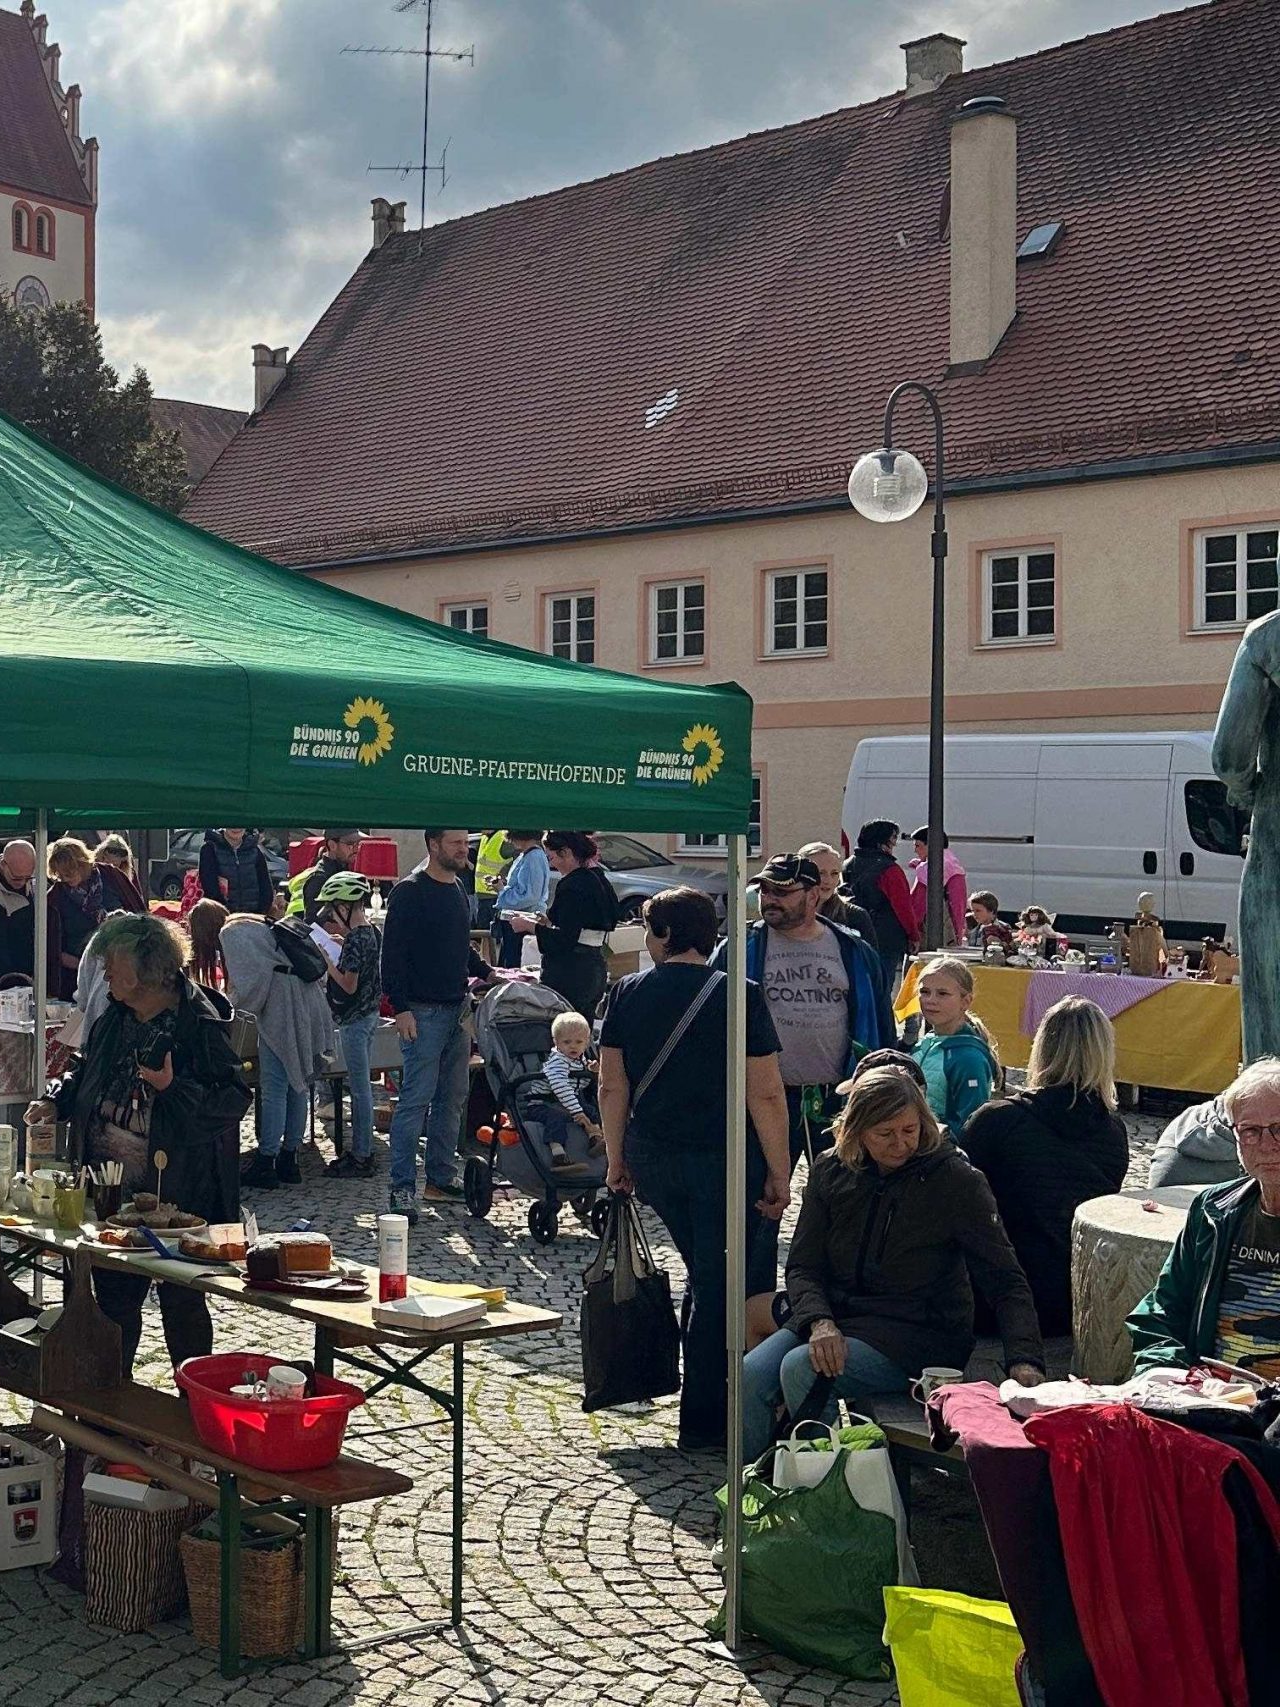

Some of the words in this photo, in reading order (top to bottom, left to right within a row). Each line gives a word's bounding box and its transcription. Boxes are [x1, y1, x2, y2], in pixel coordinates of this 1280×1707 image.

[293, 723, 342, 742] BÜNDNIS
[344, 730, 360, 743] 90
[290, 742, 310, 757] DIE
[312, 741, 359, 760] GRÜNEN
[639, 748, 681, 765] BÜNDNIS
[681, 753, 695, 766] 90
[403, 752, 626, 786] GRUENE-PFAFFENHOFEN.DE
[636, 765, 653, 778] DIE
[654, 764, 692, 781] GRÜNEN
[816, 967, 832, 985] &
[1238, 1246, 1280, 1265] DENIM
